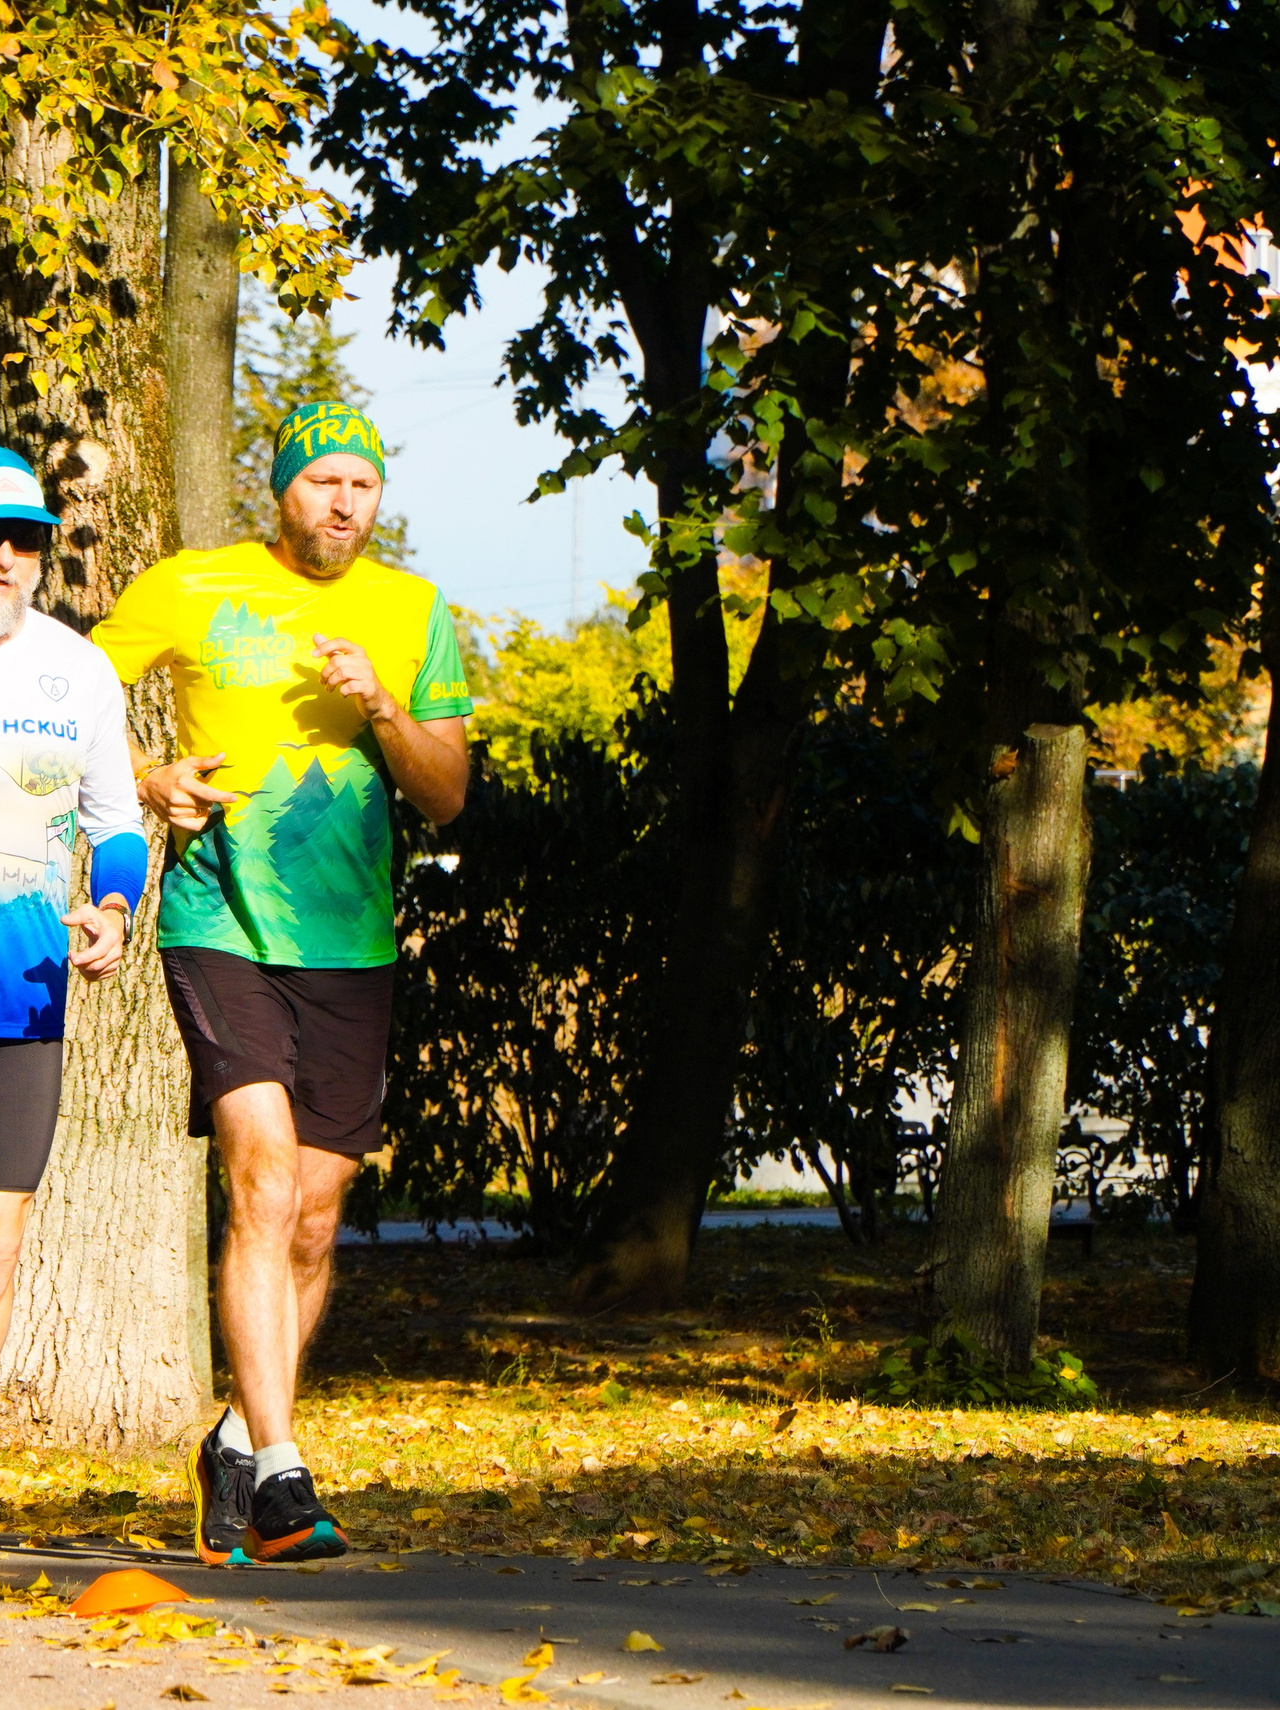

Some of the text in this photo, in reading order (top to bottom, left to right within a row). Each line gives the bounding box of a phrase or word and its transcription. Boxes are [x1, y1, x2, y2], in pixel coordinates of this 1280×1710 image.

[201, 634, 293, 665] BLIZKO
[208, 658, 290, 689] TRAIL
[278, 1470, 302, 1482] HOKA
